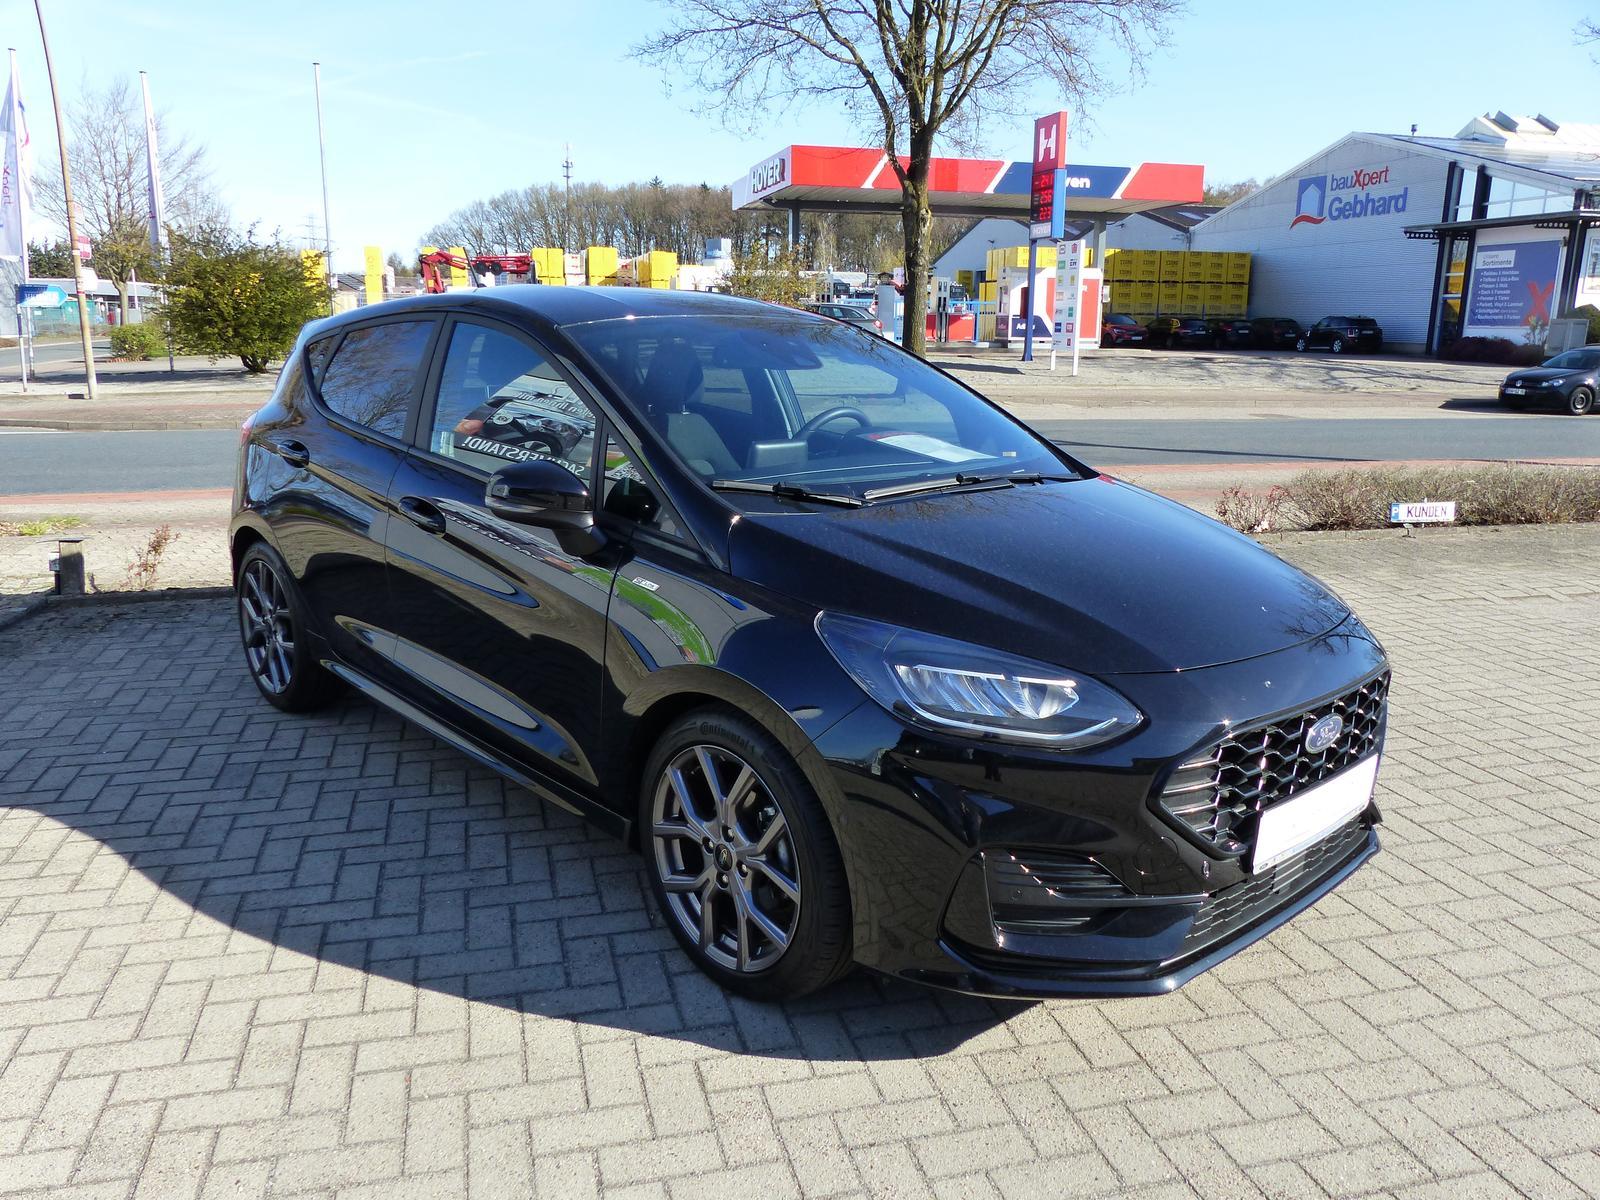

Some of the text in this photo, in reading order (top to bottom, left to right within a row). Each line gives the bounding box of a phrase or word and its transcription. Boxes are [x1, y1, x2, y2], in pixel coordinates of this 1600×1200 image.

[752, 158, 785, 193] HOYER
[1330, 165, 1389, 191] bauXpert
[1328, 187, 1408, 221] Gebhard
[1407, 505, 1447, 518] KUNDEN
